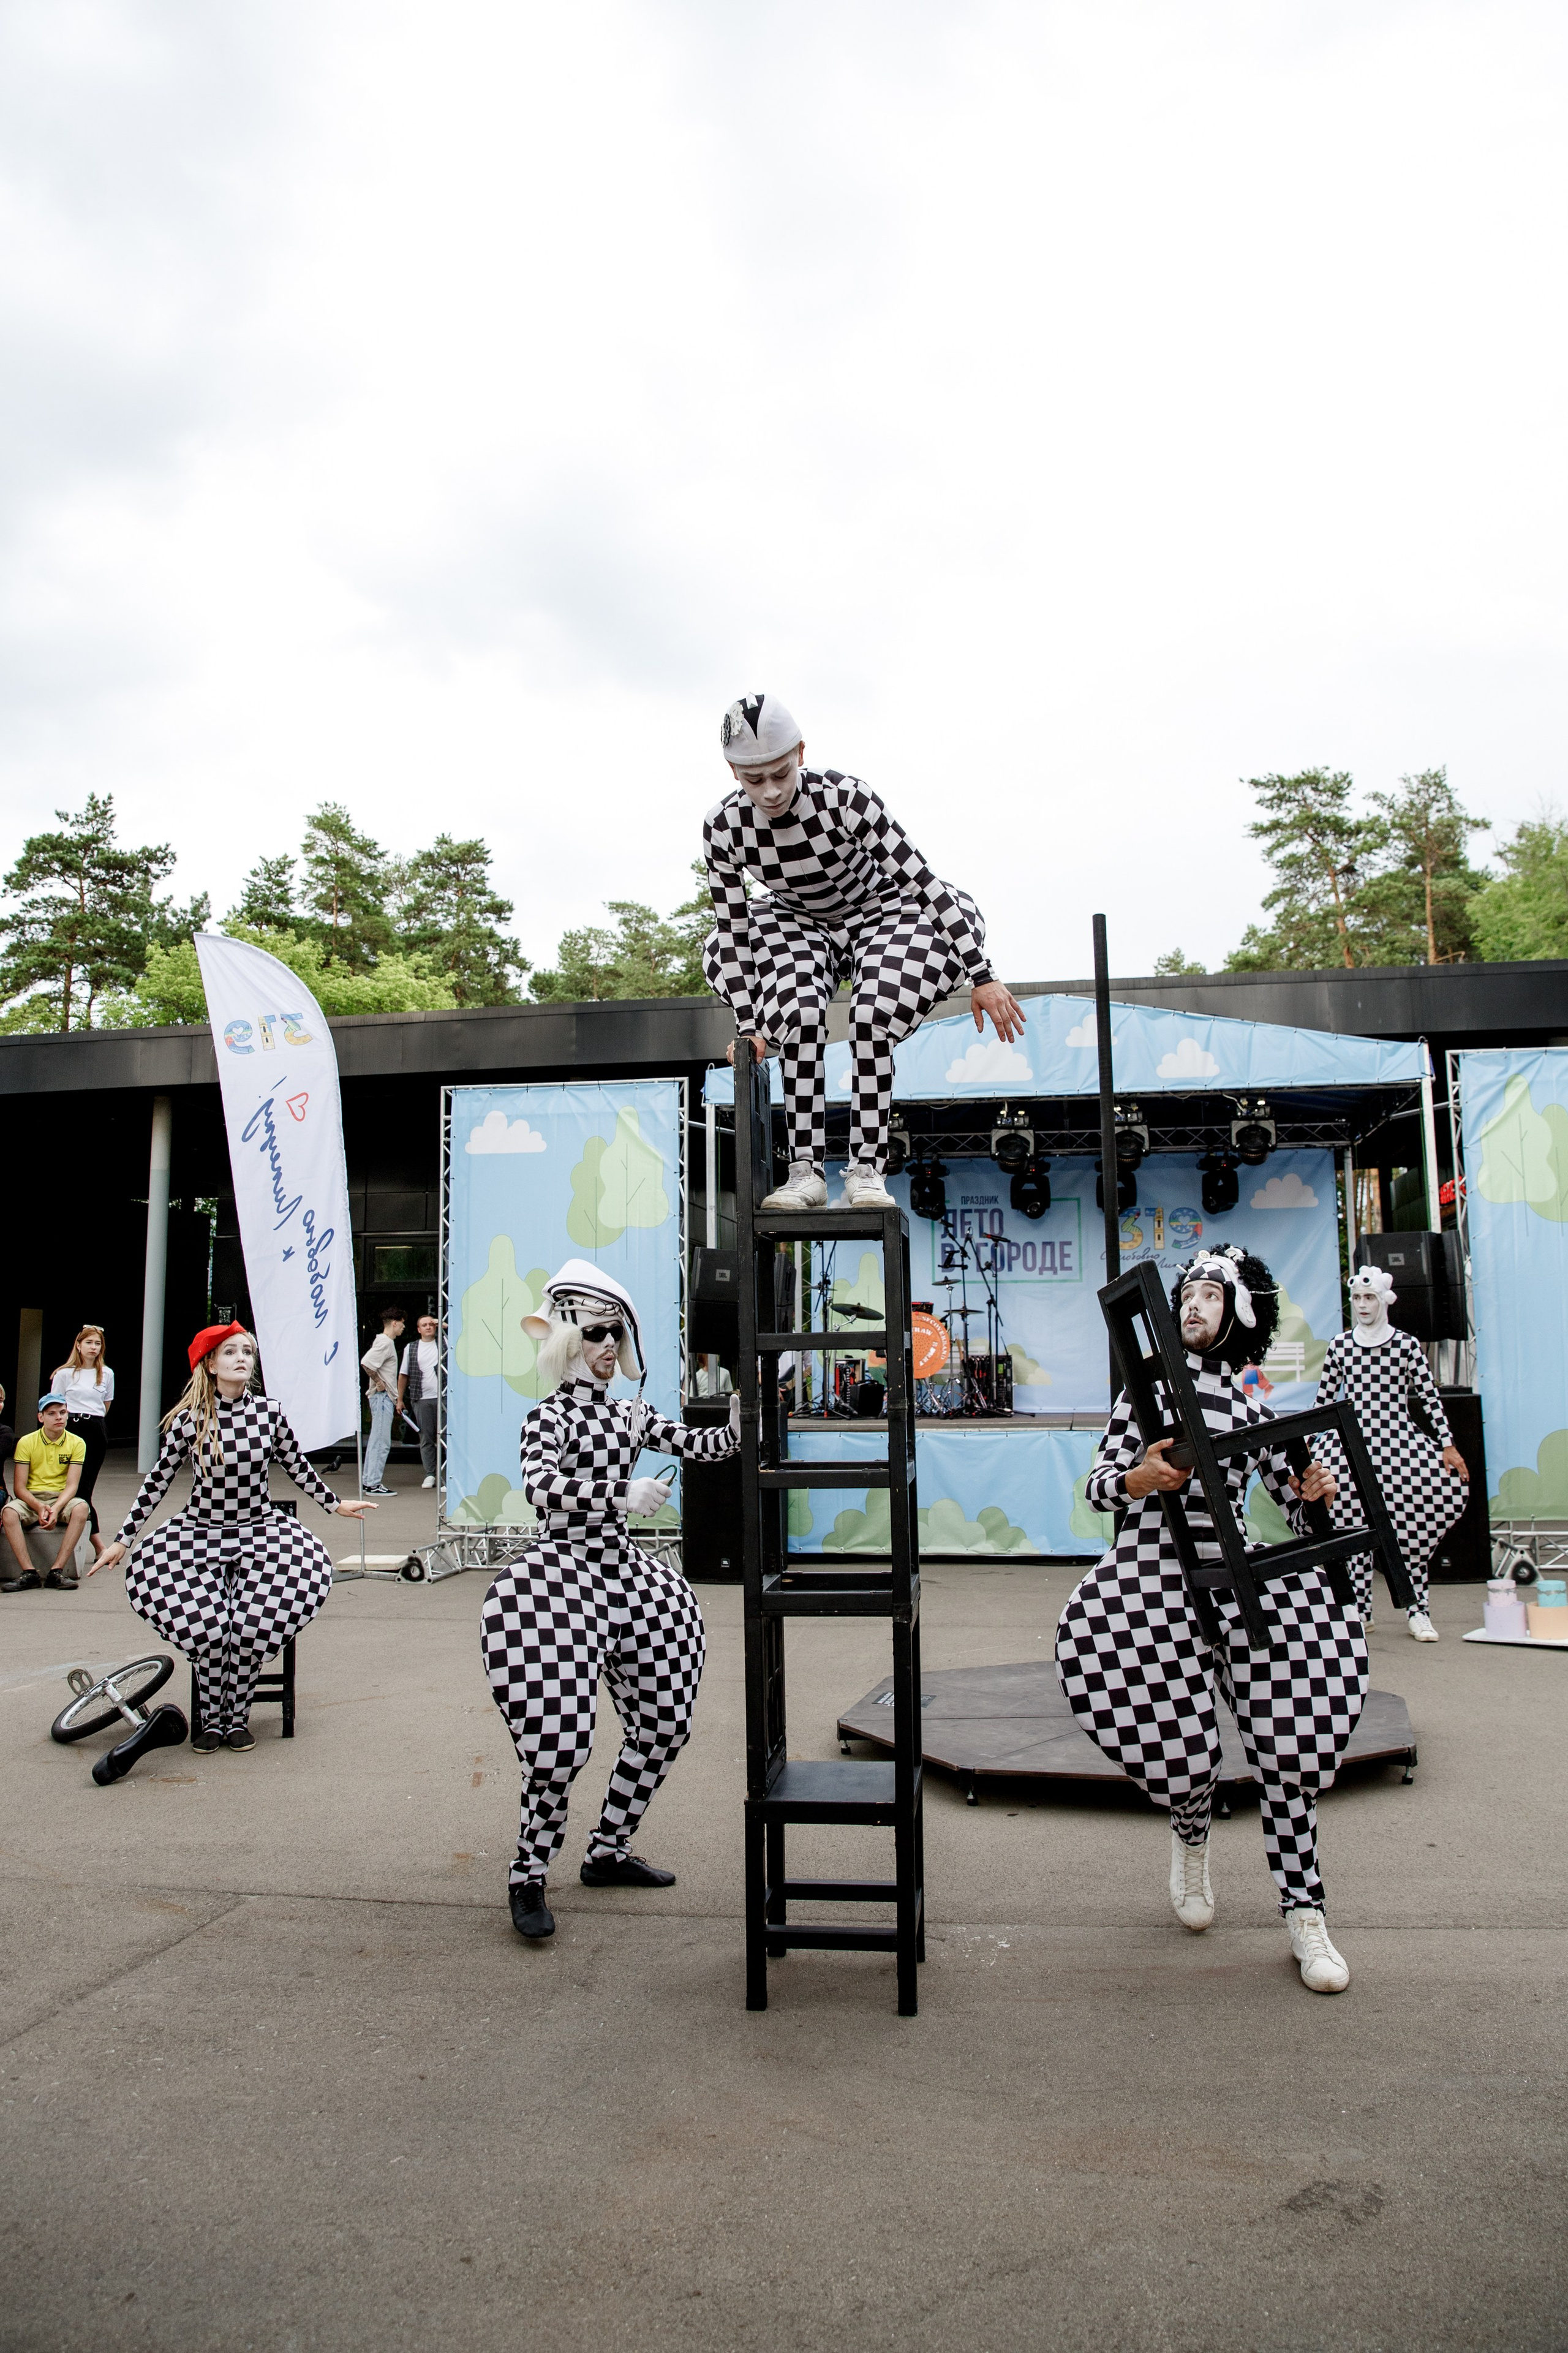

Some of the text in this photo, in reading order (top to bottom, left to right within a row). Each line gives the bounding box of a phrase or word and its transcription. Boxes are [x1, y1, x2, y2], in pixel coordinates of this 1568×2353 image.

[961, 1196, 999, 1205] ПРАЗДНИК
[941, 1208, 1004, 1239] ЛЕТО
[1119, 1207, 1203, 1250] 319
[941, 1241, 1073, 1275] В ГОРОДЕ
